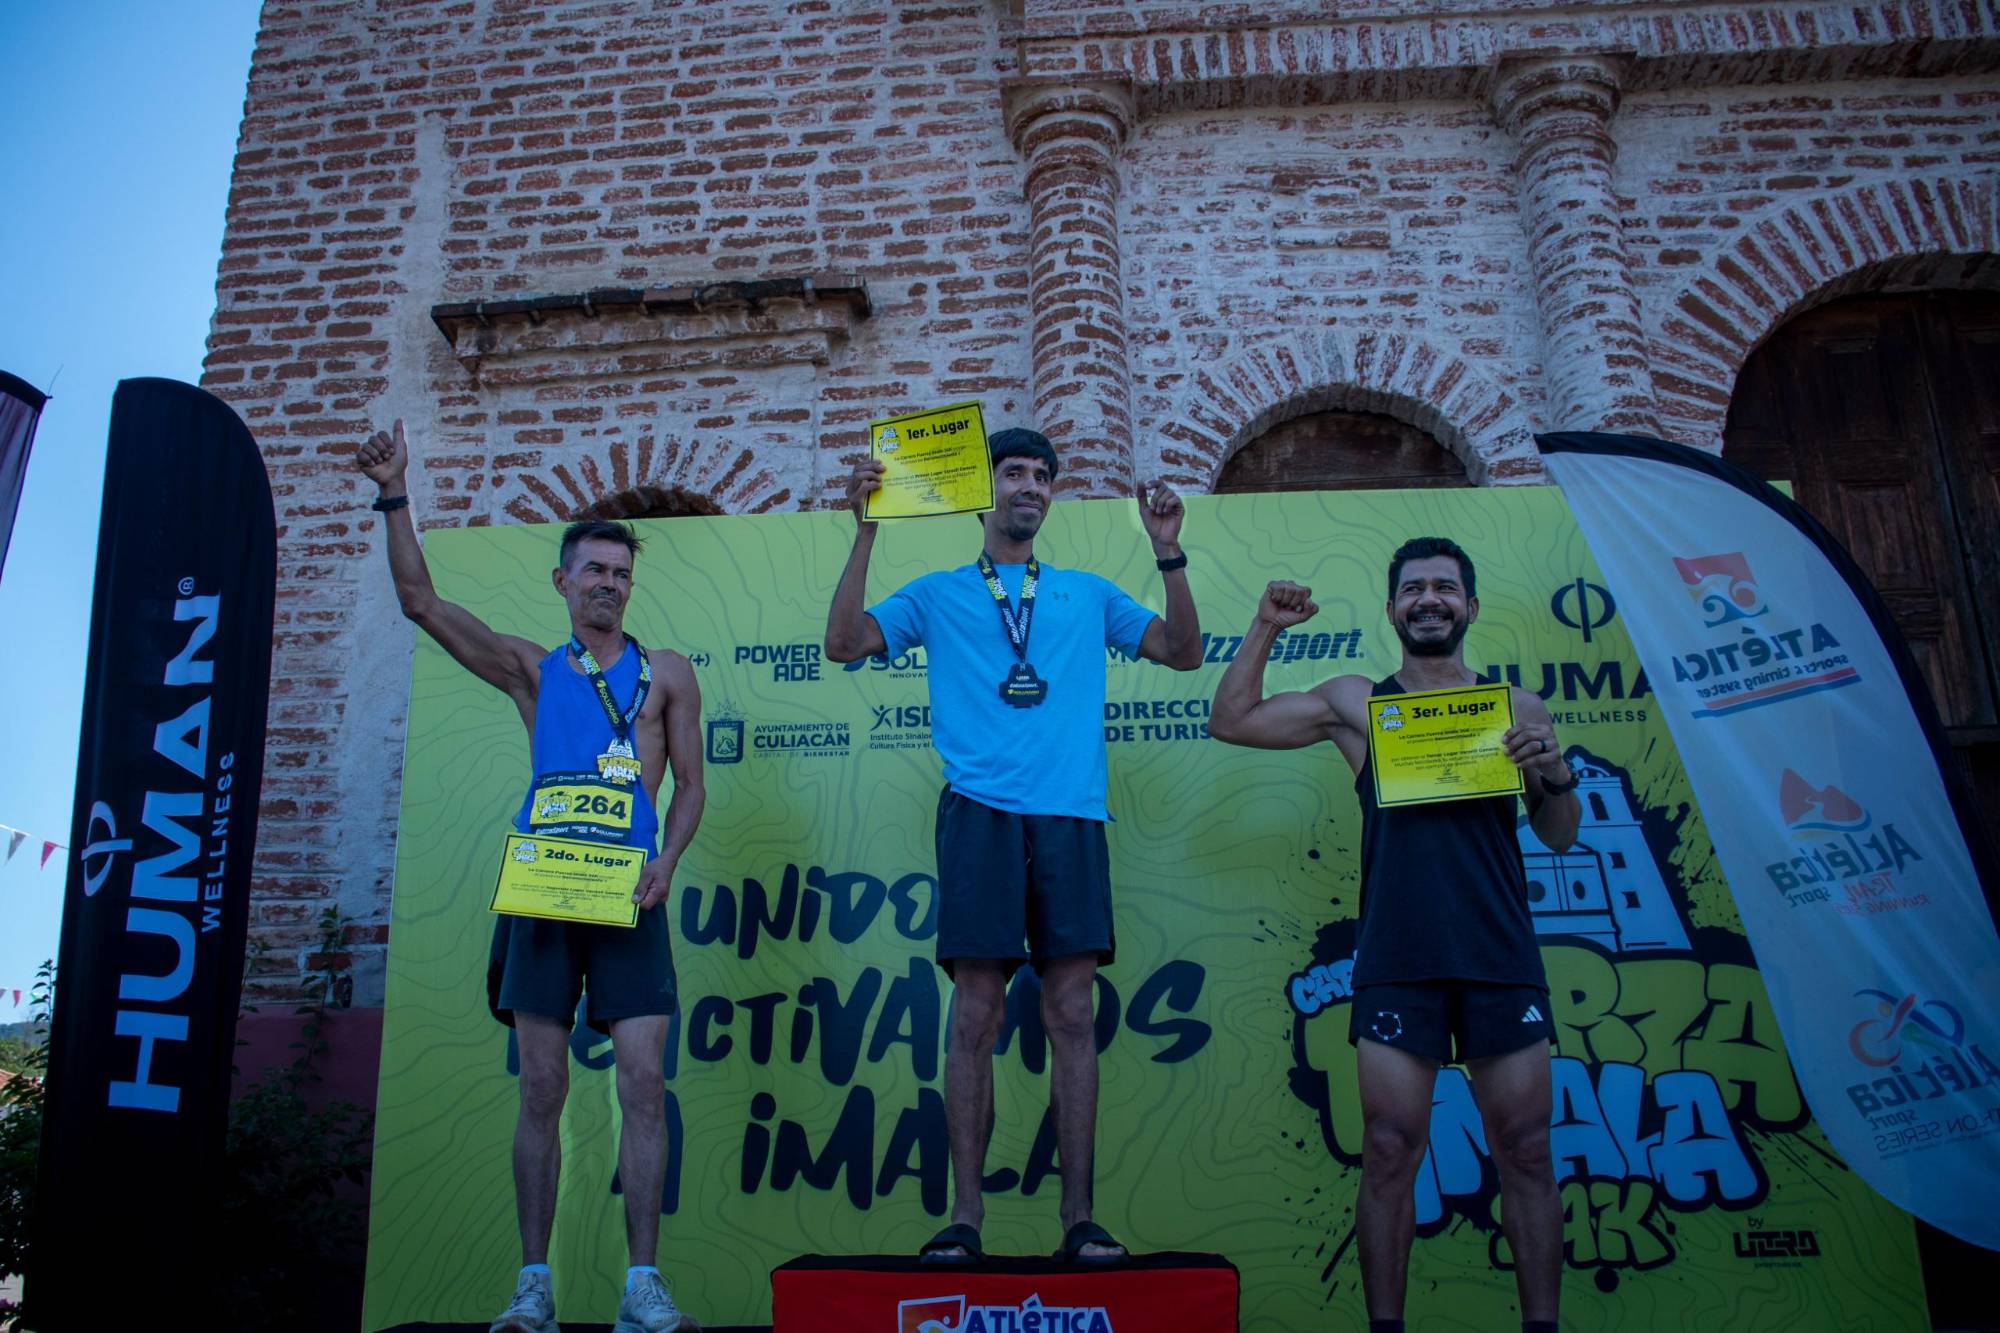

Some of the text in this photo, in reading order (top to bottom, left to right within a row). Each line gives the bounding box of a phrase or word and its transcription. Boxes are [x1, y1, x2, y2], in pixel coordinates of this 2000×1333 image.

[906, 427, 930, 440] 1er.
[932, 419, 970, 435] Lugar
[735, 644, 821, 664] POWER
[774, 663, 821, 682] ADE
[1412, 706, 1443, 719] 3er.
[1448, 701, 1496, 715] Lugar
[1550, 710, 1647, 724] WELLNESS
[754, 724, 832, 733] AYUNTAMIENTO
[1104, 726, 1135, 742] DE
[754, 732, 850, 748] CULIACÁN
[573, 794, 626, 820] 264
[202, 751, 234, 932] WELLNESS
[108, 590, 220, 1113] HUMAN
[544, 849, 579, 861] 2do.
[584, 853, 631, 867] Lugar
[1748, 1216, 1764, 1229] by
